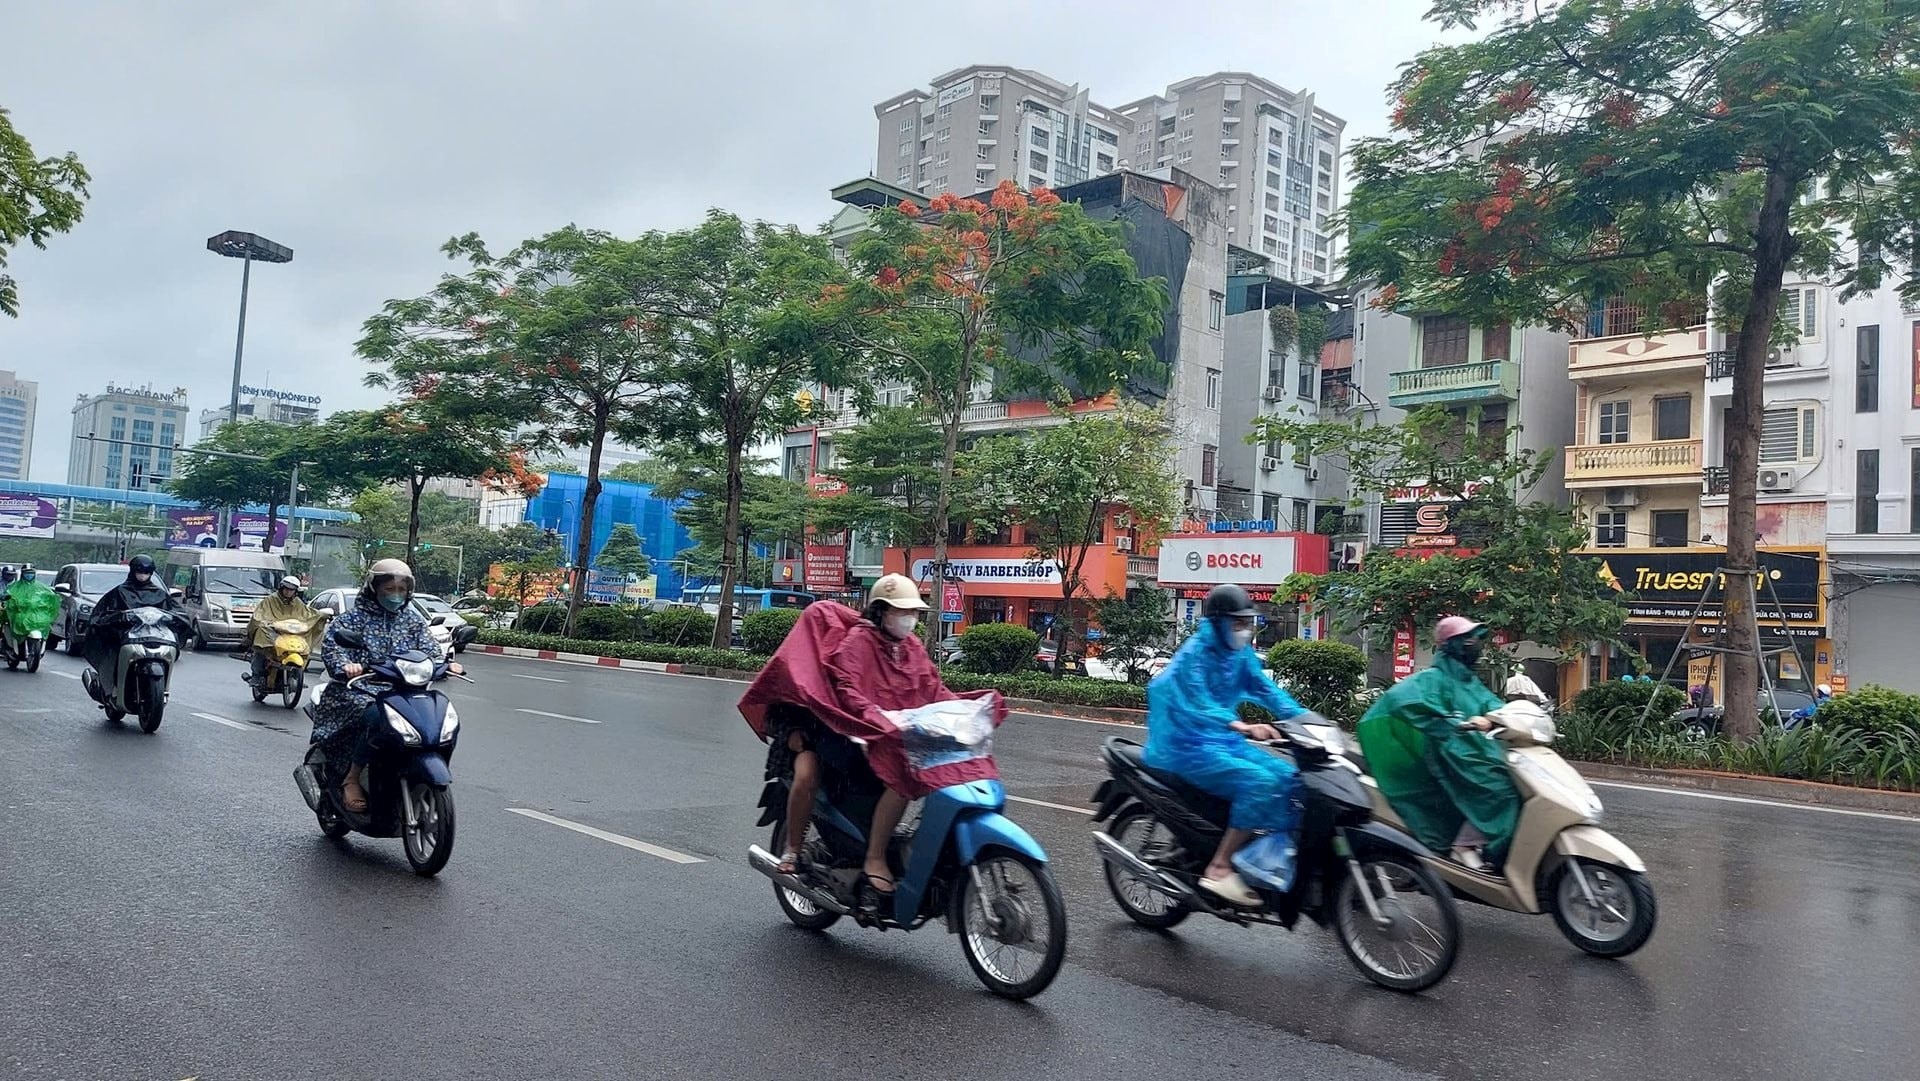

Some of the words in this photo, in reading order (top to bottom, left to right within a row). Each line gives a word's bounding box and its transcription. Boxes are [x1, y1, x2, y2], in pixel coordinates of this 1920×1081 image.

[144, 390, 175, 402] BANK
[1207, 554, 1262, 568] BOSCH
[975, 563, 1053, 578] BARBERSHOP
[1690, 664, 1718, 674] IPHOE
